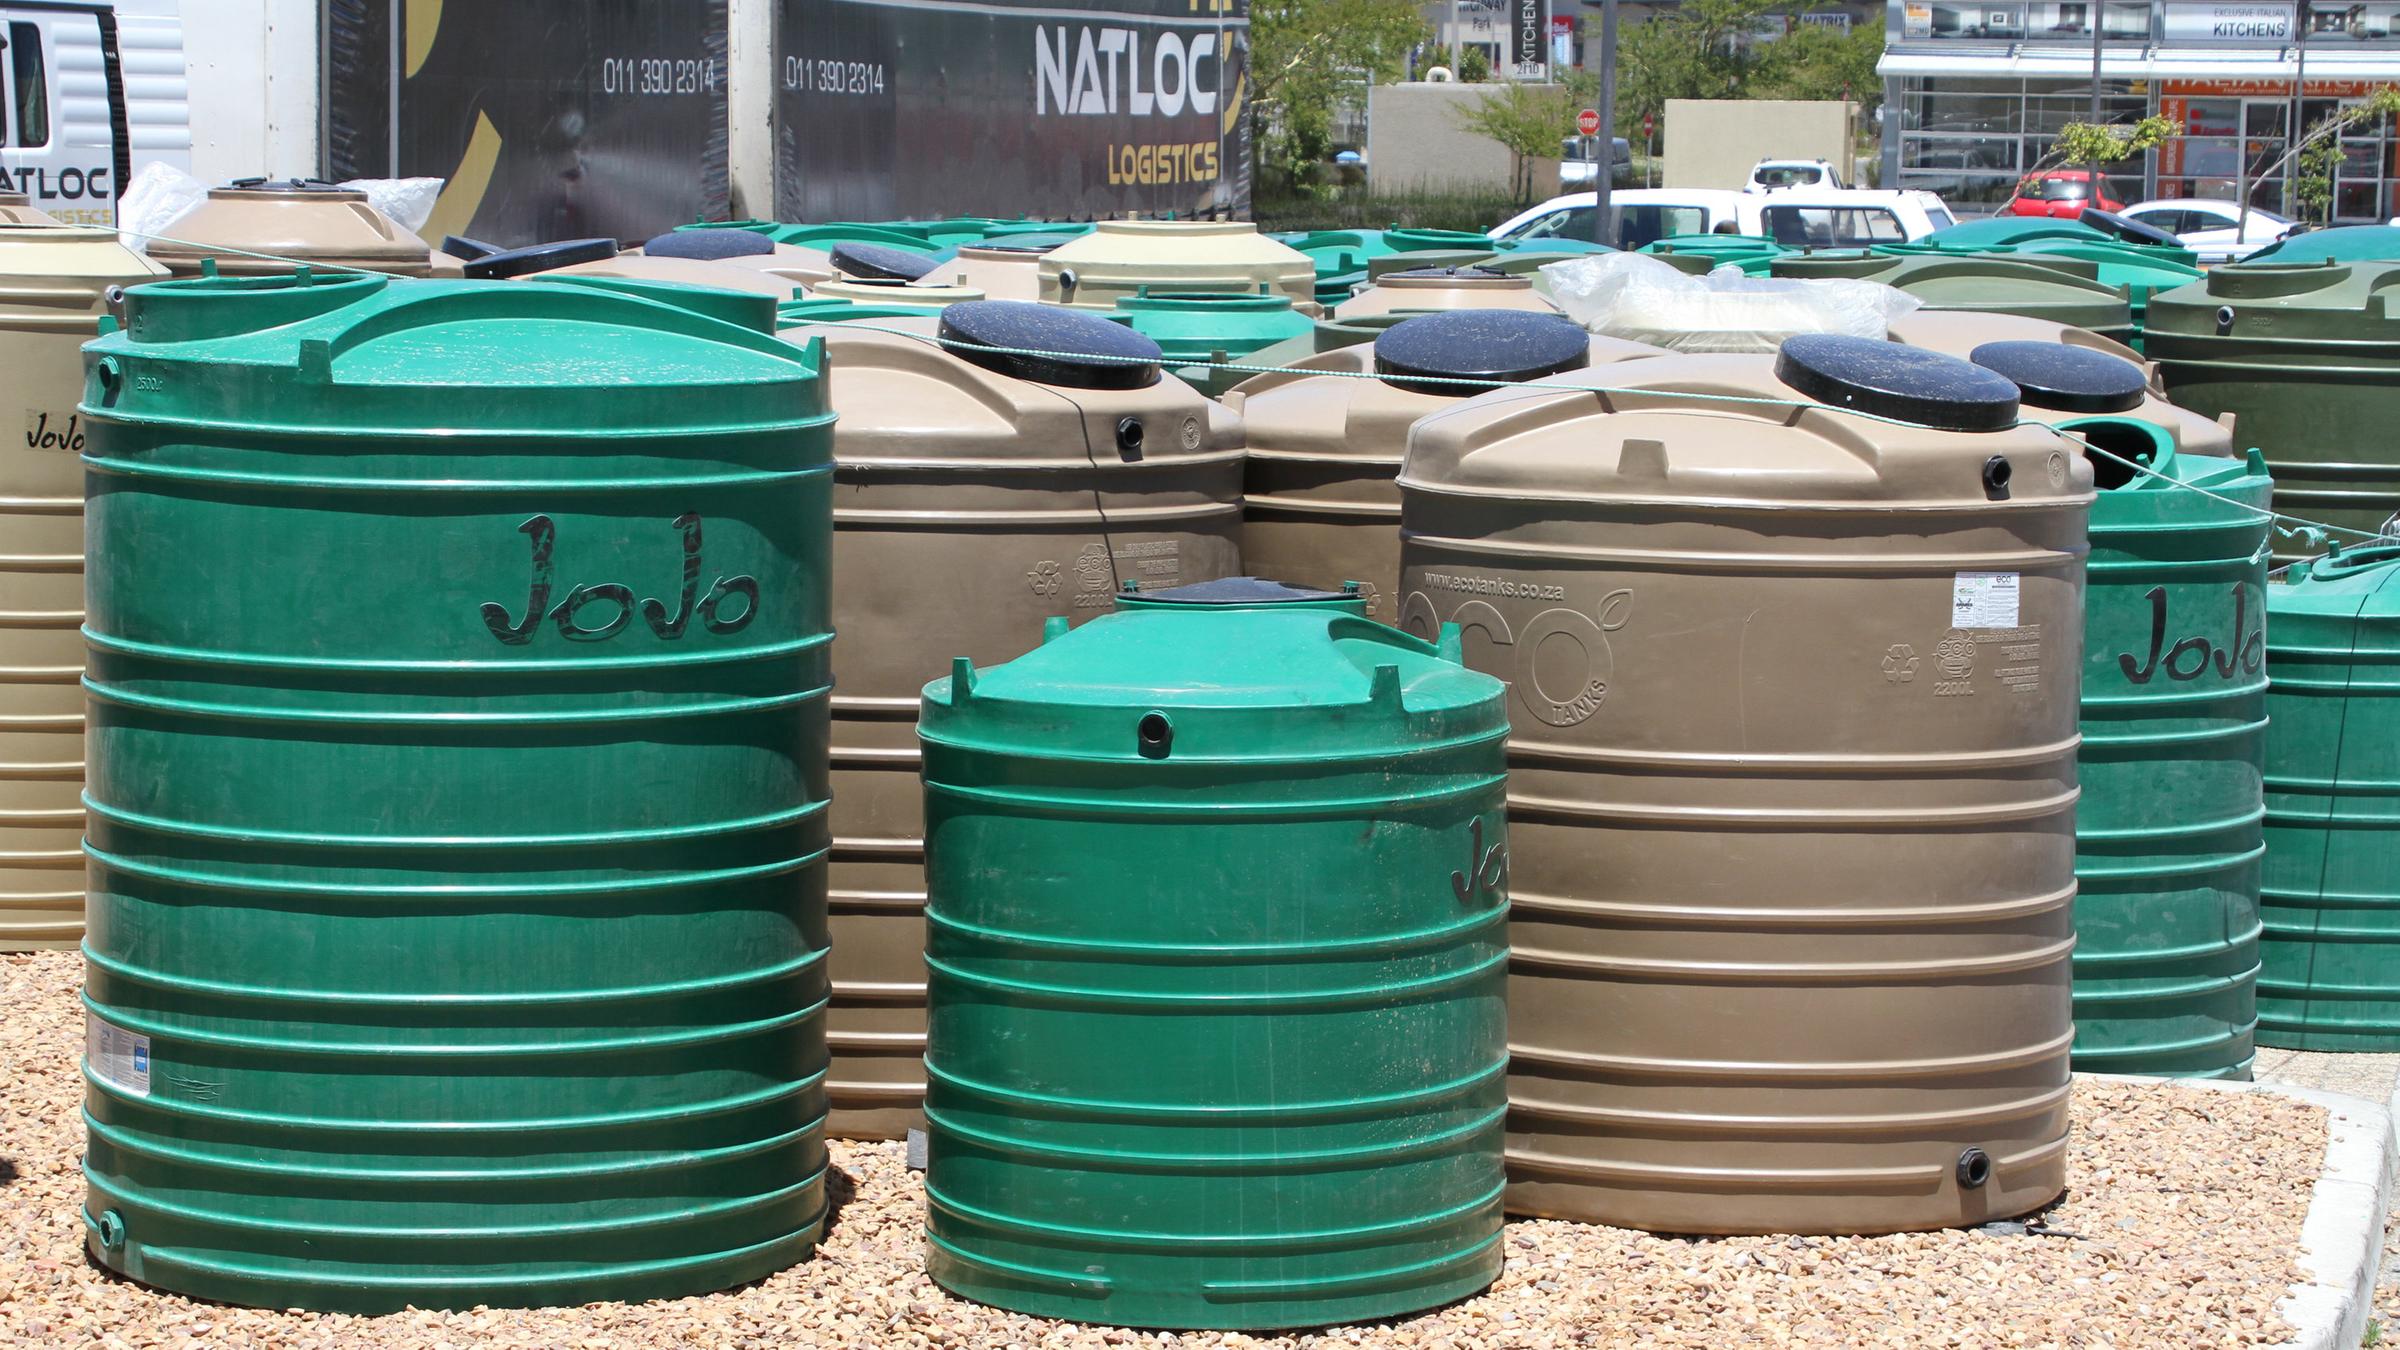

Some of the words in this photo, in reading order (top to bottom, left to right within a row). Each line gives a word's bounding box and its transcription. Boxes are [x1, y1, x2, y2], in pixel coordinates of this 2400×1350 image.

[2214, 7, 2254, 17] EXCLUSIVE
[2257, 8, 2286, 17] ITALIAN
[2213, 22, 2285, 37] KITCHENS
[603, 58, 634, 93] 011
[641, 59, 671, 93] 390
[676, 59, 714, 94] 2314
[786, 56, 813, 92] 011
[818, 60, 845, 92] 390
[848, 62, 884, 94] 2314
[1035, 24, 1217, 117] NATLOC
[1579, 117, 1598, 128] STOP
[1108, 142, 1218, 185] LOGISTICS
[480, 511, 759, 646] JoJo
[1424, 571, 1565, 601] www.ecotanks.co.za
[1996, 575, 2011, 583] eco
[1074, 594, 1113, 608] 2200L
[2118, 580, 2263, 685] JoJo
[1552, 679, 1608, 725] TANKS
[1933, 681, 1975, 696] 2200L
